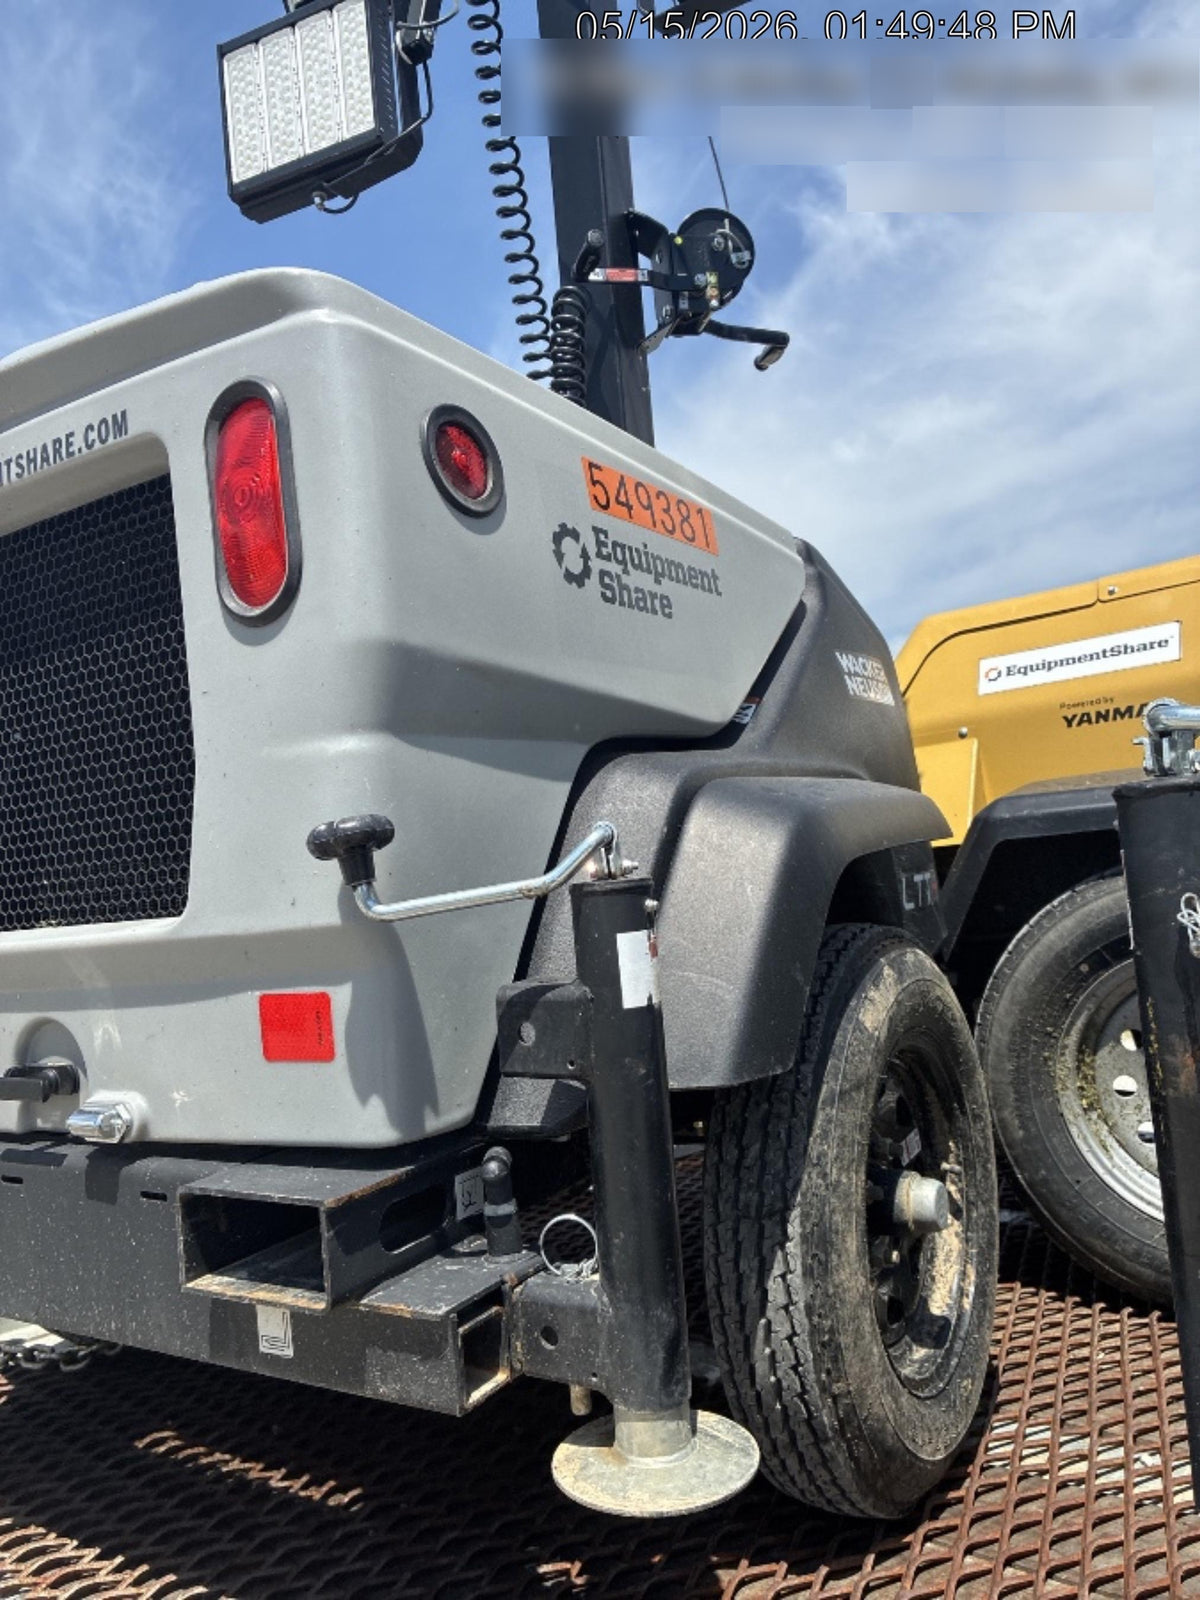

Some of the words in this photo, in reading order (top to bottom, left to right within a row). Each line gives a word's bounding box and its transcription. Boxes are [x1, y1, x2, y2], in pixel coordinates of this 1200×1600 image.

[0, 408, 128, 486] TSHARE.COM
[587, 461, 711, 549] 549381
[592, 525, 722, 597] Equipment
[599, 568, 673, 619] Share
[1005, 638, 1169, 676] EquipmentShare
